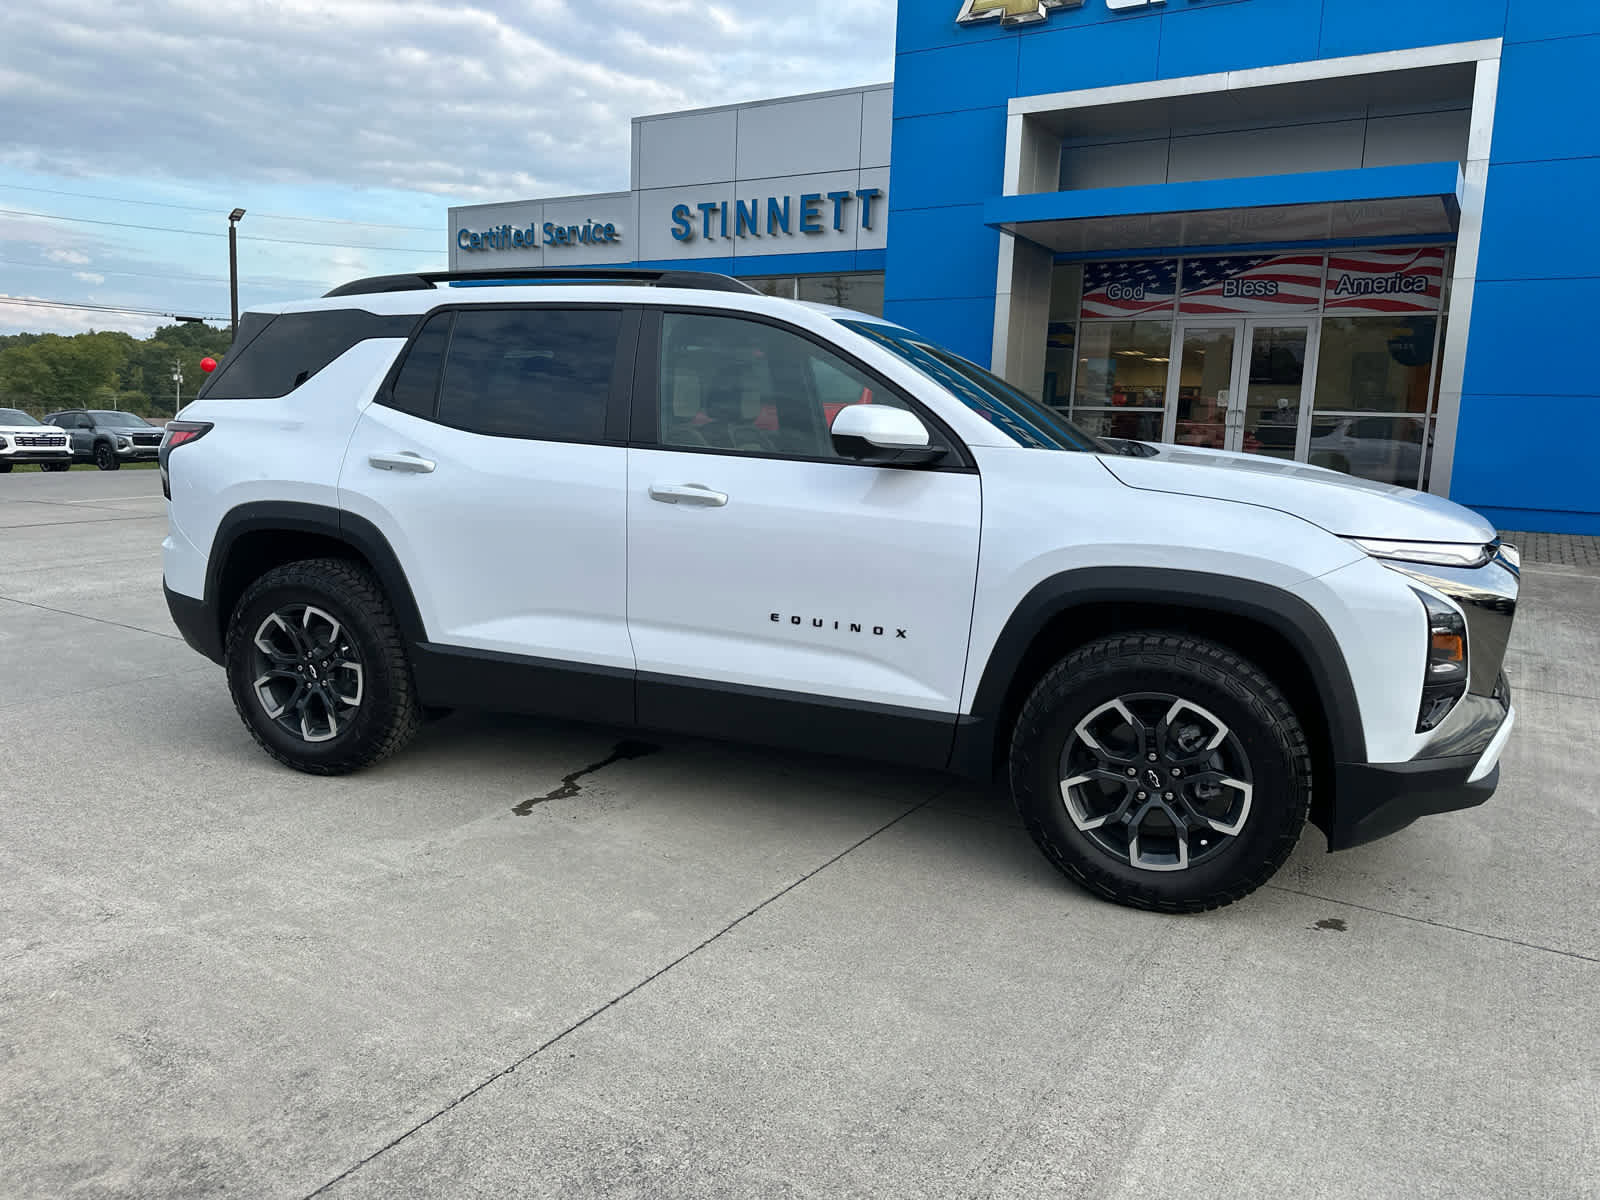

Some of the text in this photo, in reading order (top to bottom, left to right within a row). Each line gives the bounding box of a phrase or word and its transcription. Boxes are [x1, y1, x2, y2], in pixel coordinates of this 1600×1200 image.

[671, 188, 881, 241] STINNETT
[457, 218, 616, 250] Certified Service
[1106, 272, 1428, 300] God Bless America
[770, 612, 907, 639] EQUINOX
